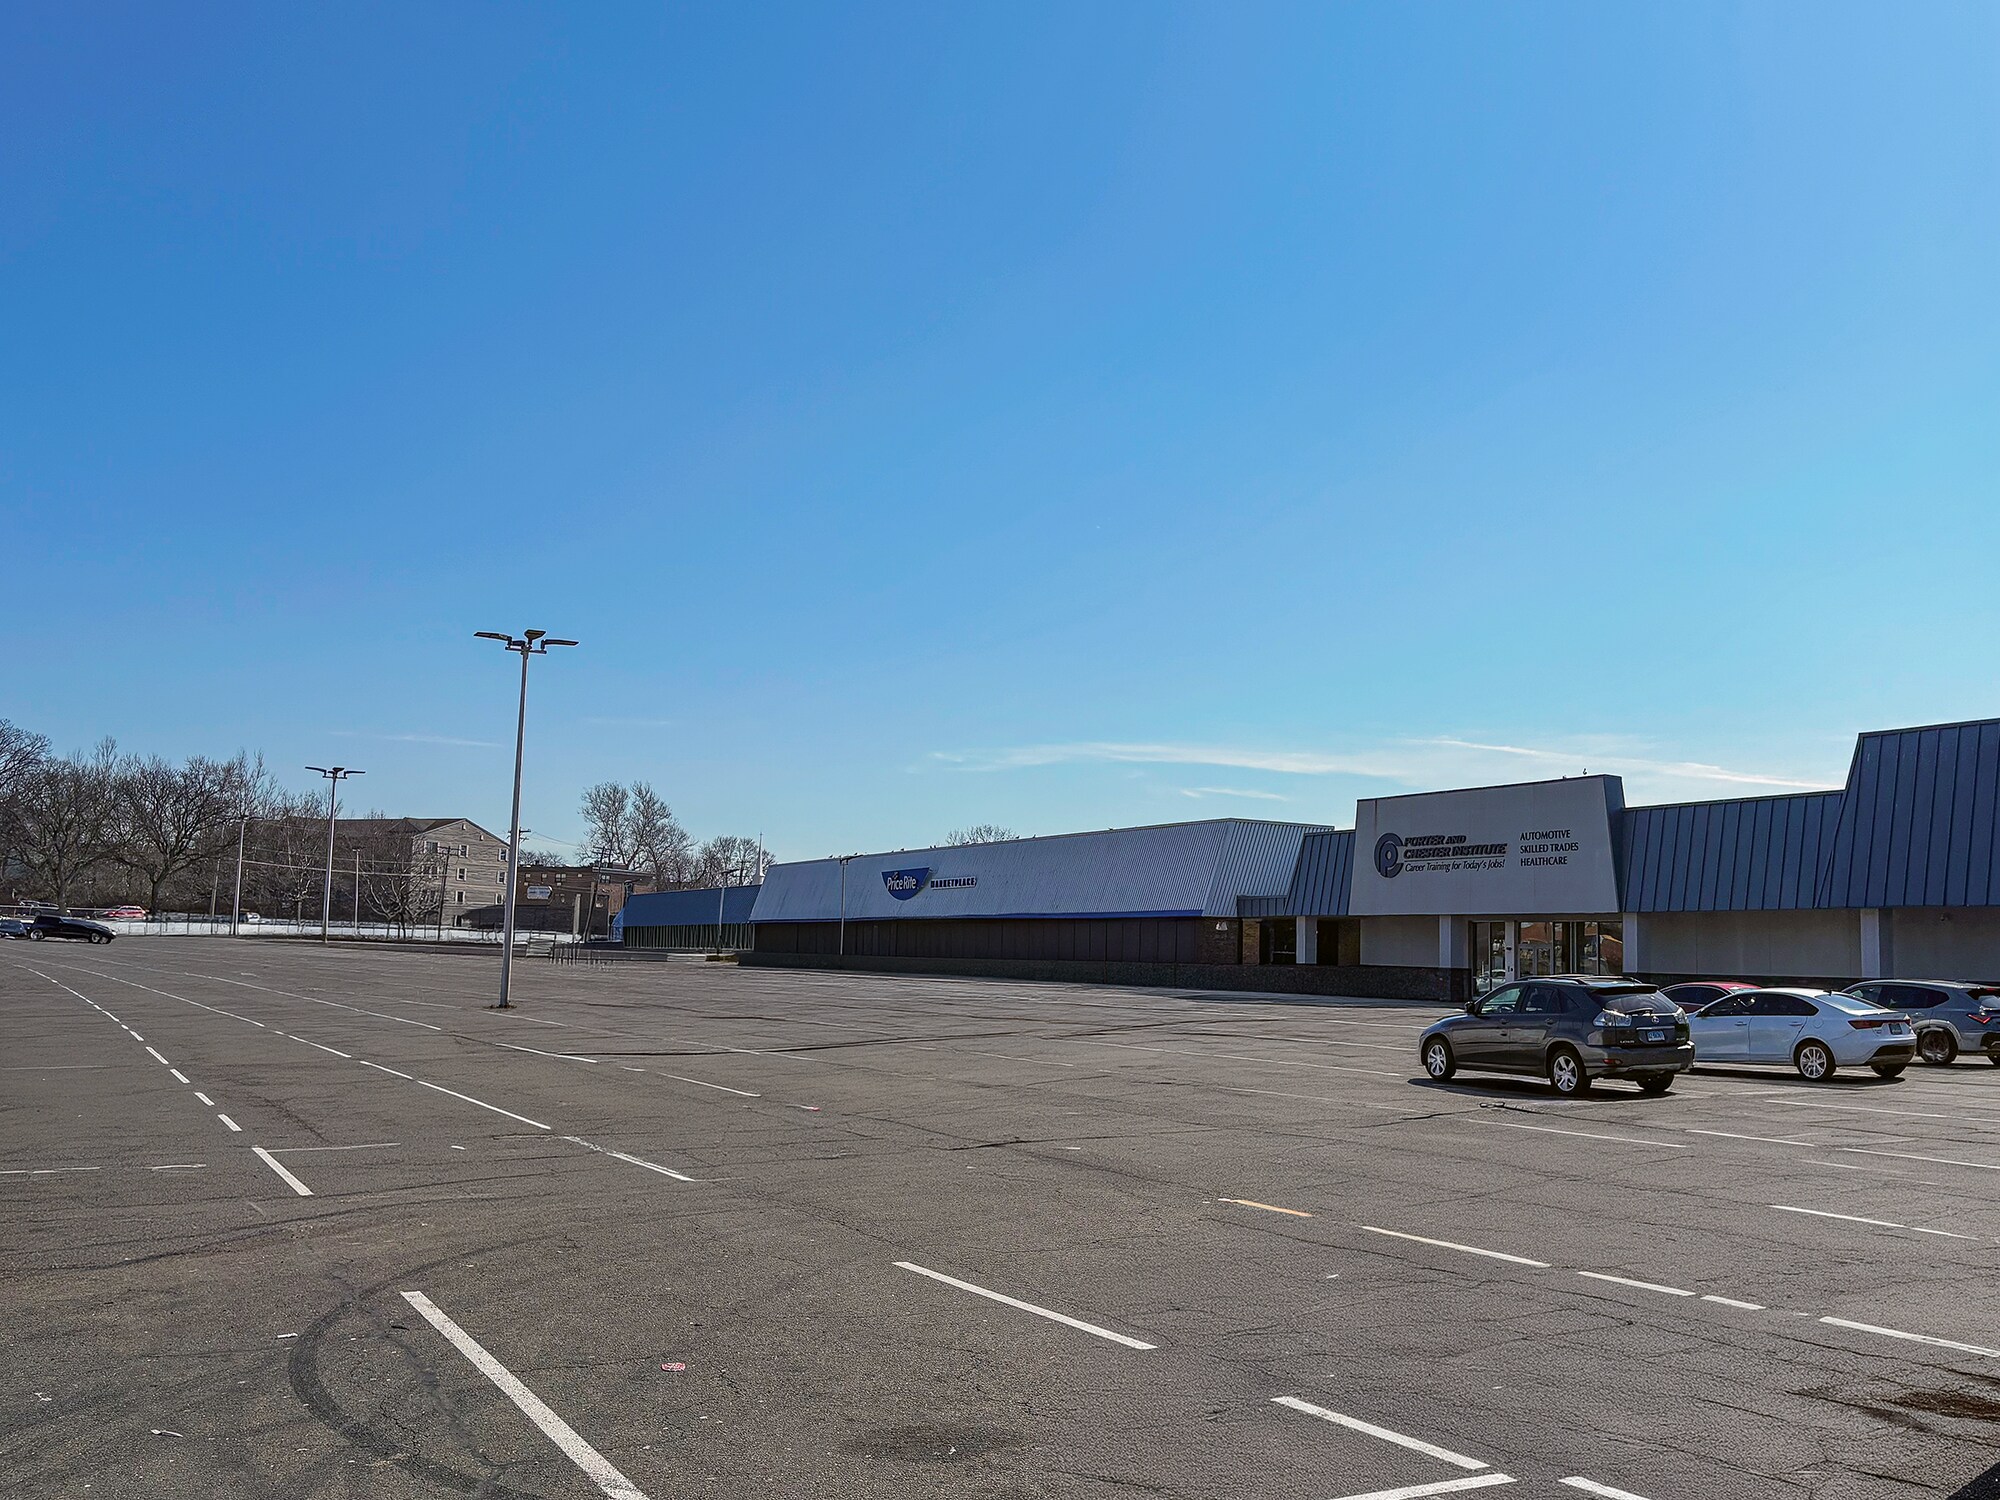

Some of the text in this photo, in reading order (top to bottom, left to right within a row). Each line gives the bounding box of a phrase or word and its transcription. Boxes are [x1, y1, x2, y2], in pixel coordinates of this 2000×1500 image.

[1520, 829, 1571, 840] AUTOMOTIVE
[1405, 835, 1467, 847] PORTER AND
[1403, 843, 1508, 860] CHESTER INSTITUTE
[1520, 842, 1579, 854] SKILLED TRADES
[1405, 859, 1505, 873] Career Training for Today's Jobs!
[1520, 856, 1568, 867] HEALTHCARE
